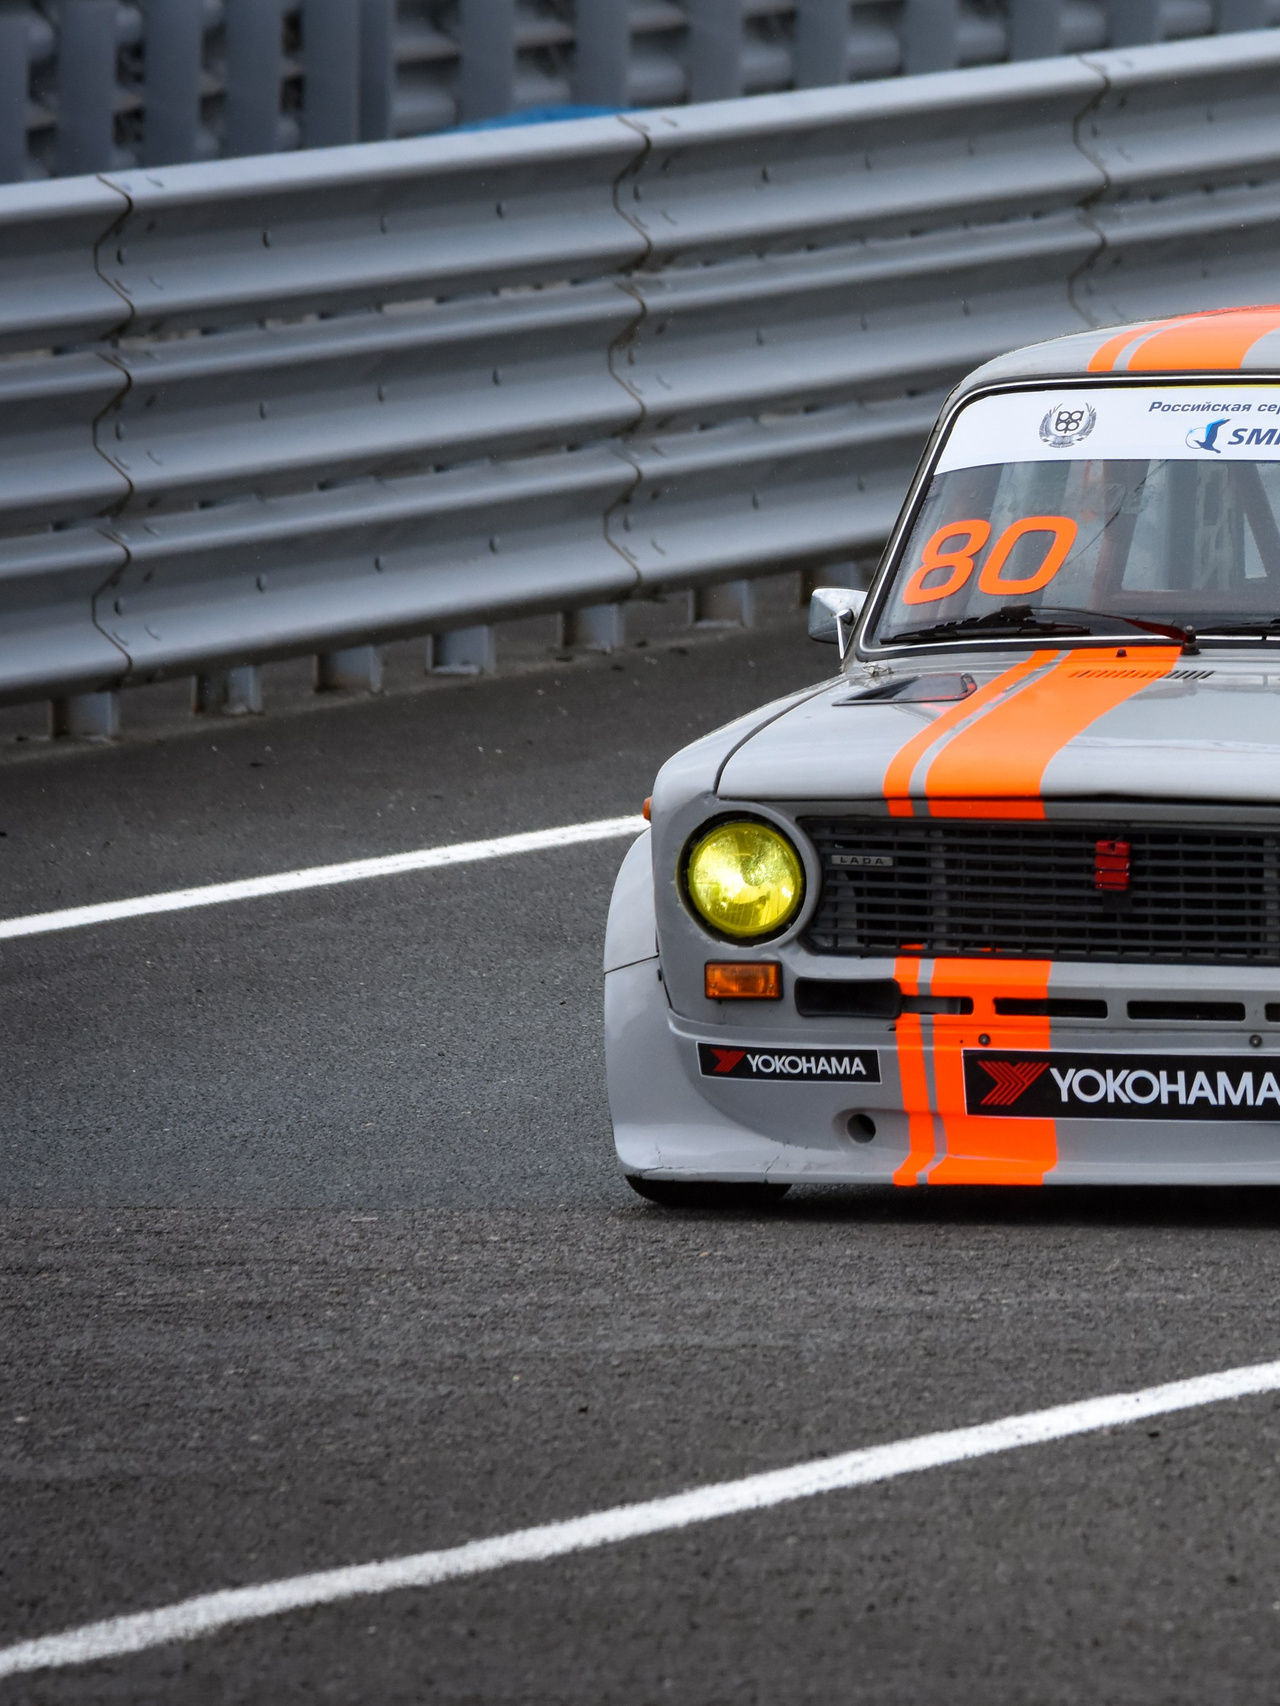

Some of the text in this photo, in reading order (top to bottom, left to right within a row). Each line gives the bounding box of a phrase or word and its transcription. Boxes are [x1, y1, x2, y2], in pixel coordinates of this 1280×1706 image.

[1148, 401, 1252, 413] Российская
[903, 516, 1078, 605] 80
[840, 856, 884, 865] LADA
[746, 1054, 867, 1075] YOKOHAMA
